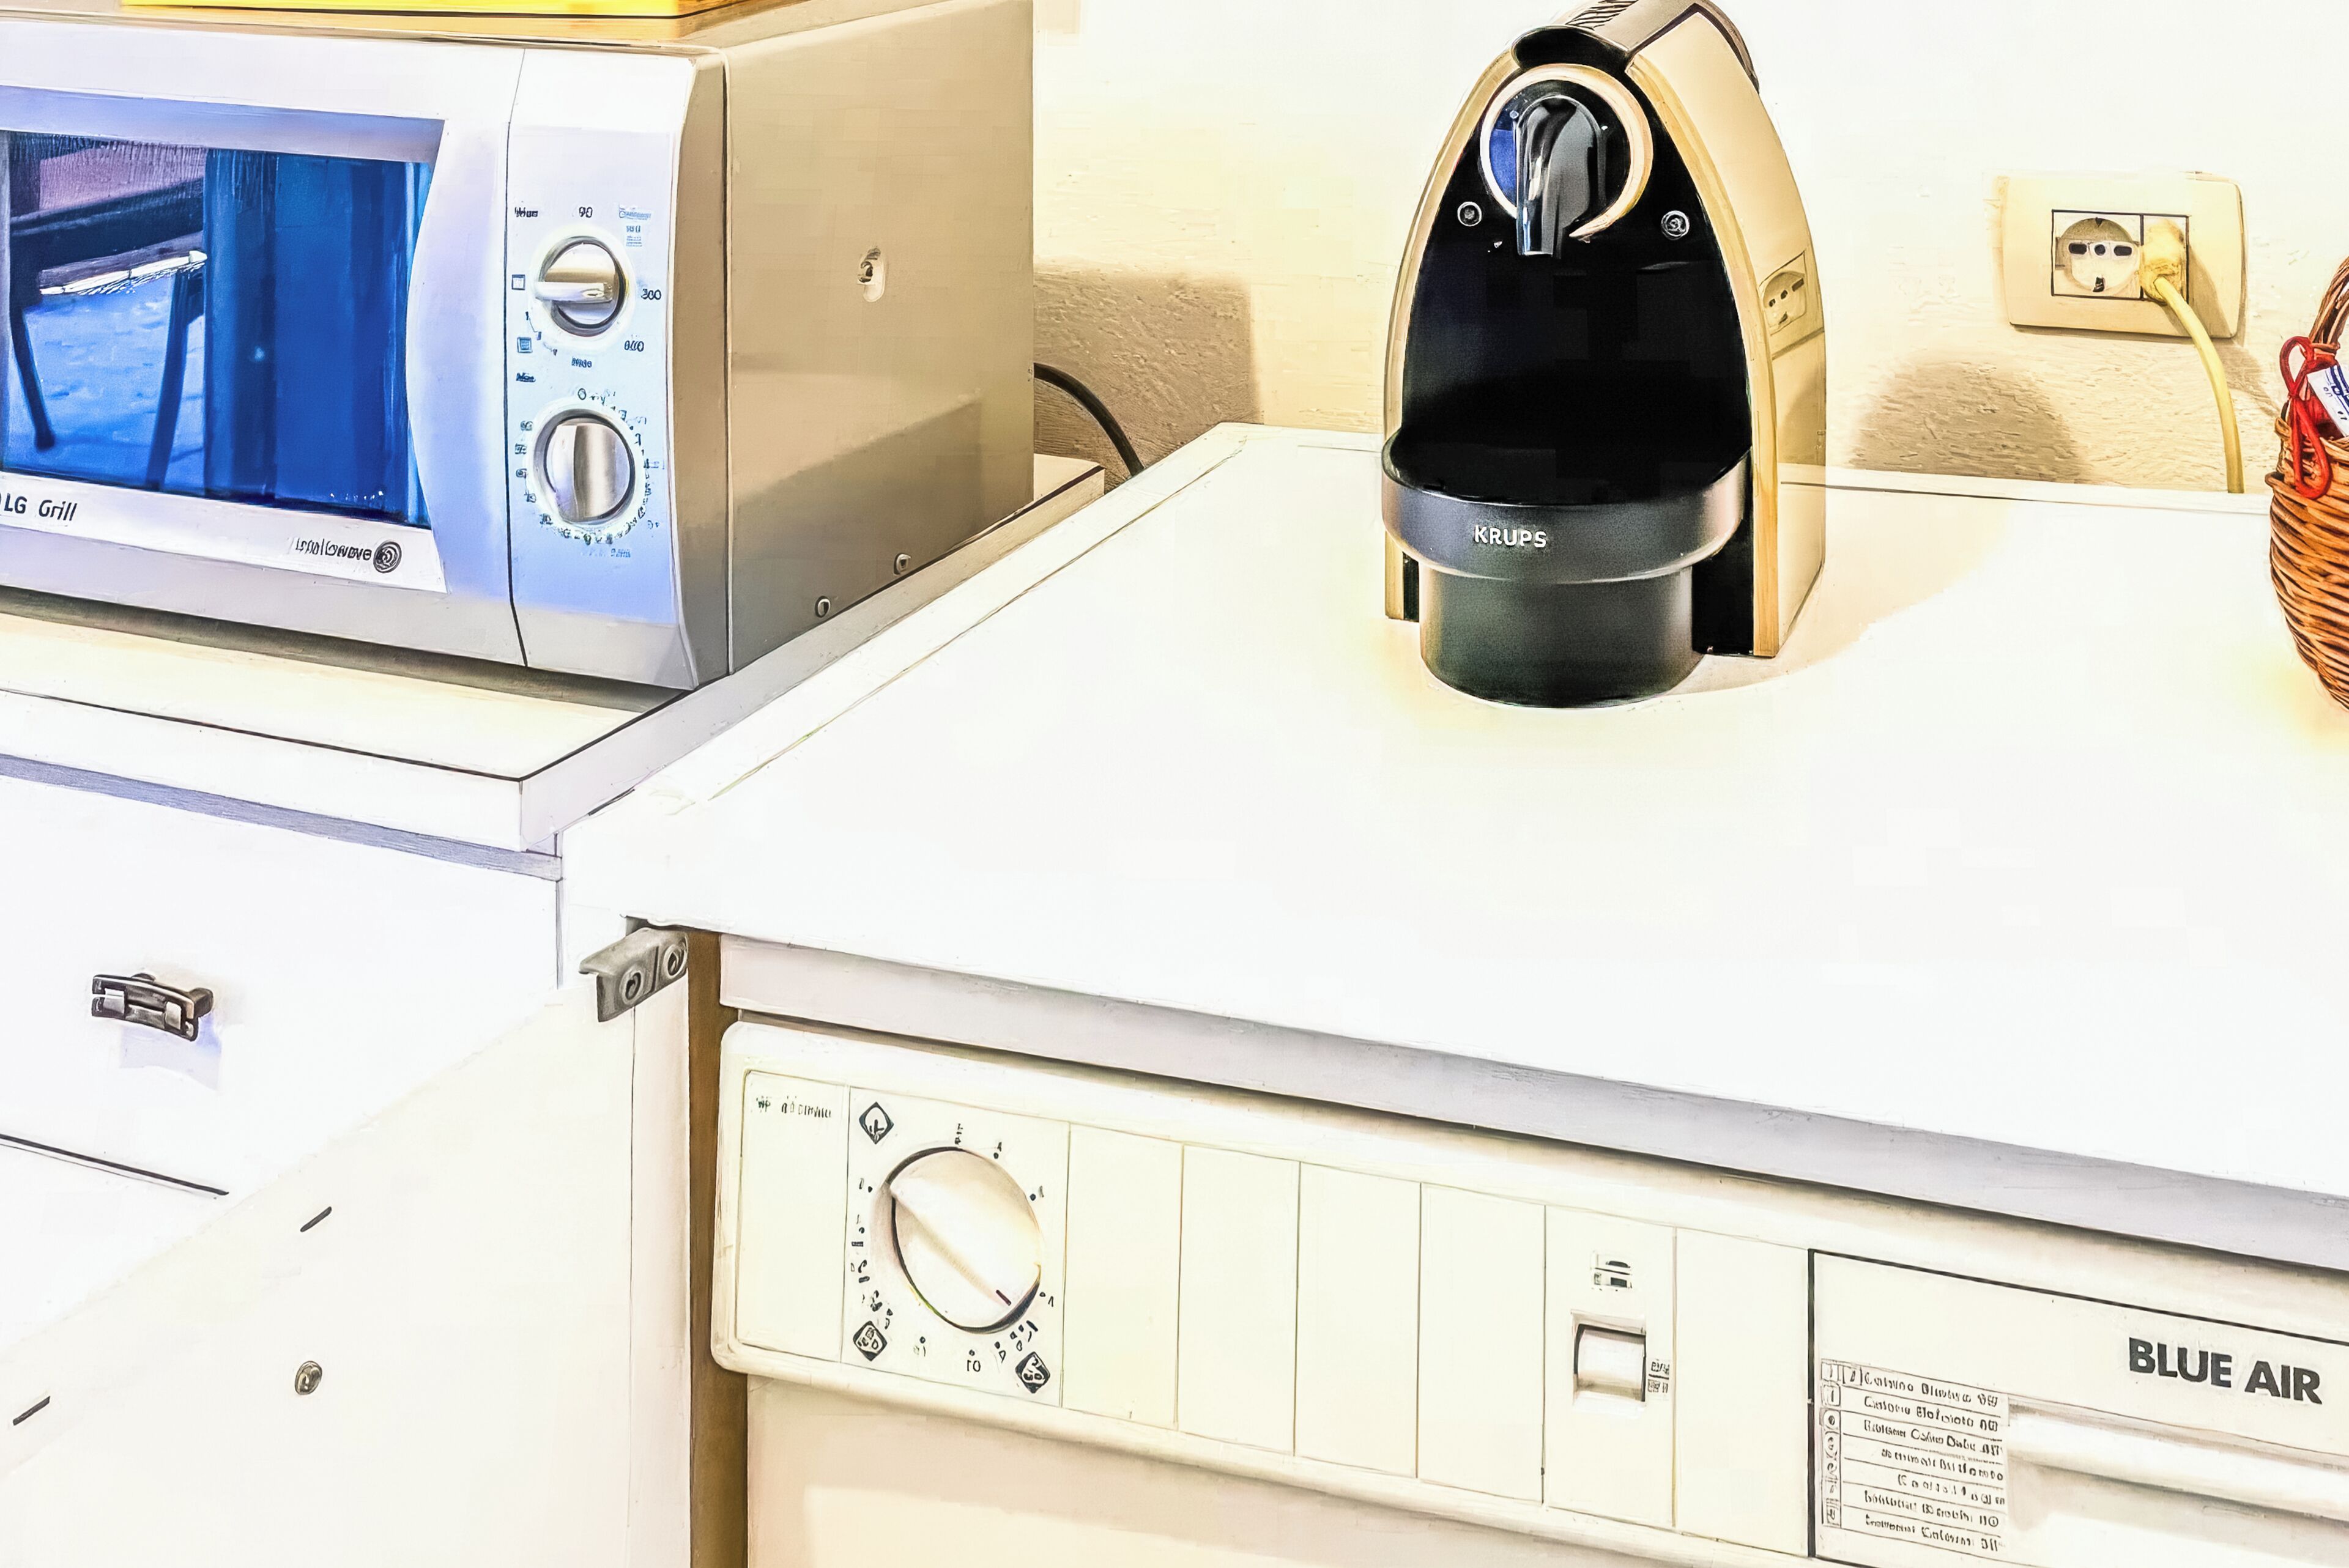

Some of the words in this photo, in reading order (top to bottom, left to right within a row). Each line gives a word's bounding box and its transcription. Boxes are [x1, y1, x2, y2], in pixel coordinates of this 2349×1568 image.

[4, 492, 28, 514] LG
[39, 499, 78, 521] Grill
[1474, 525, 1547, 548] KRUPS
[2129, 1337, 2232, 1388] BLUE
[2244, 1360, 2323, 1405] AIR
